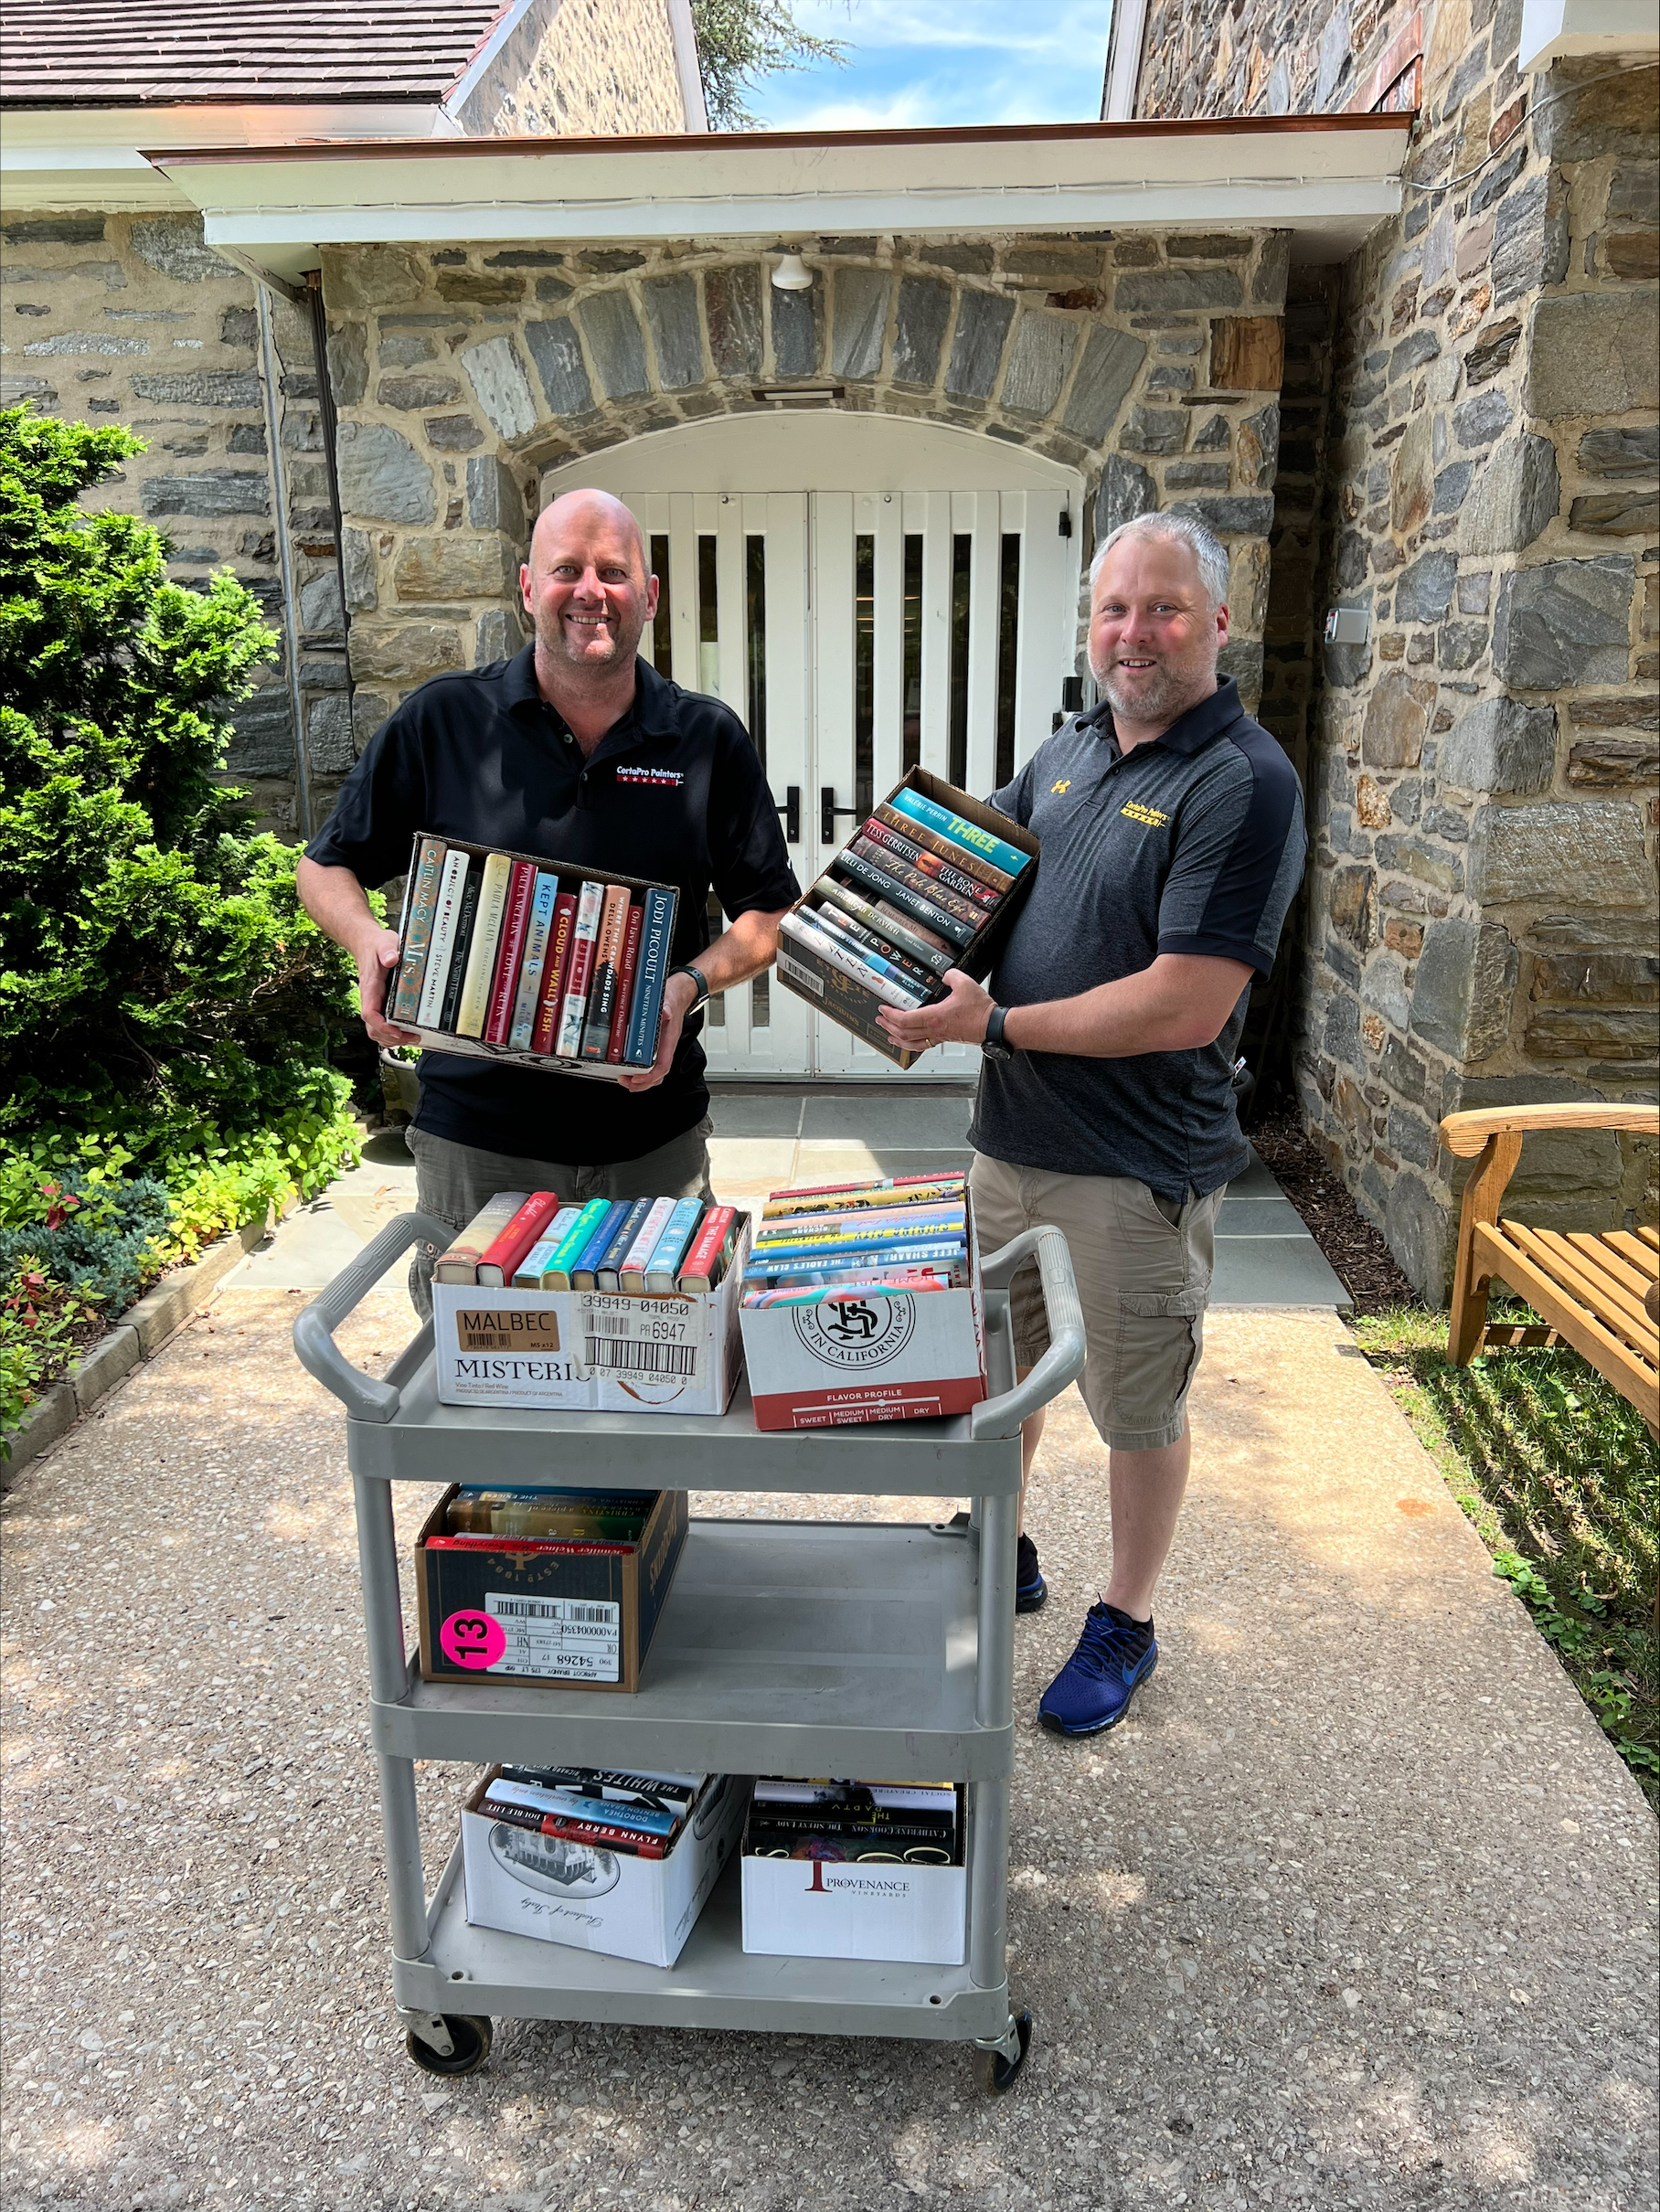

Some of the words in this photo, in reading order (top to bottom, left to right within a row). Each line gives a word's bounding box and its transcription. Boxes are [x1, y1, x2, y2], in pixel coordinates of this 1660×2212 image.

[617, 766, 649, 776] CertaPro
[651, 769, 680, 779] Painters
[905, 795, 926, 810] VALÉRIE
[926, 807, 946, 822] PERRIN
[949, 814, 998, 852] THREE
[867, 824, 884, 839] TESS
[882, 835, 921, 861] GERRITSEN
[883, 813, 925, 843] THREE
[931, 841, 974, 872] JUNES
[422, 850, 436, 888] CAITLIN
[453, 856, 460, 867] AN
[447, 869, 458, 896] OBJECT
[517, 867, 528, 897] PAULA
[885, 857, 903, 875] The
[905, 873, 926, 888] Pale
[924, 885, 947, 901] Blue
[948, 899, 964, 917] Eye
[939, 870, 974, 897] GARDEN
[941, 867, 956, 878] THE
[957, 877, 980, 894] BONE
[466, 884, 475, 899] Alice
[491, 884, 503, 909] PAULA
[841, 855, 857, 867] LILLI
[857, 864, 868, 875] DE
[867, 873, 890, 888] JONG
[896, 890, 920, 907] JANET
[920, 904, 951, 926] BENTON
[417, 892, 429, 922] MACY
[446, 899, 452, 909] OF
[538, 885, 551, 915] KEPT
[607, 903, 616, 926] DELIA
[615, 897, 624, 924] WHERE
[631, 911, 640, 924] On
[653, 894, 667, 924] JODI
[440, 912, 450, 941] BEAUTY
[460, 902, 473, 937] McDermott
[556, 917, 569, 953] CLOUD
[628, 927, 638, 944] Java
[529, 920, 545, 975] ANIMALS
[601, 930, 612, 958] OWENS
[403, 939, 425, 977] Mrs.
[455, 951, 464, 962] The
[480, 947, 490, 980] CIRCLING
[625, 947, 634, 970] Road
[645, 929, 661, 983] PICOULT
[870, 937, 923, 975] POWER
[432, 954, 442, 976] STEVE
[503, 952, 514, 979] LOVE
[604, 946, 616, 991] CRAWDADS
[548, 970, 560, 998] WALL
[427, 979, 436, 1007] MARTIN
[620, 979, 629, 1010] Lawrence
[642, 985, 651, 1016] NINETEEN
[496, 991, 507, 1016] RUIN
[601, 993, 609, 1013] SING
[516, 1003, 527, 1037] MILLIKEN
[522, 1012, 531, 1029] KATE
[542, 1007, 553, 1032] FISH
[616, 1011, 624, 1037] Osborne
[638, 1018, 646, 1046] MINUTES
[718, 1207, 731, 1223] CAITLIN
[706, 1226, 719, 1236] THE
[791, 1226, 828, 1234] RICHARD
[696, 1237, 714, 1259] DAMAGE
[883, 1251, 928, 1262] SHAARA
[930, 1249, 959, 1258] JEFF
[767, 1262, 790, 1271] CLAW
[847, 1278, 886, 1287] FIRE
[583, 1295, 689, 1315] 39949-04050
[463, 1313, 550, 1331] MALBEC
[641, 1324, 650, 1335] PA
[653, 1322, 686, 1341] 6947
[810, 1332, 826, 1349] IN
[827, 1324, 904, 1362] CALIFORNIA
[600, 1368, 611, 1377] 07
[616, 1370, 644, 1380] 39949
[649, 1373, 676, 1384] 04050
[682, 1377, 687, 1385] 0
[827, 1392, 862, 1402] FLAVOR
[864, 1389, 902, 1398] PROFILE
[833, 1409, 864, 1418] MEDIUM
[913, 1407, 930, 1415] DRY
[800, 1416, 826, 1424] SWEET
[836, 1416, 863, 1424] SWEET
[485, 1492, 517, 1500] EXILES
[452, 1539, 505, 1549] Everything
[560, 1623, 617, 1636] PA000004350
[453, 1618, 488, 1660] 13
[516, 1635, 529, 1647] NH
[607, 1643, 617, 1654] OR
[557, 1655, 592, 1666] 54268
[551, 1766, 580, 1776] RICHARD
[592, 1770, 658, 1791] WHITES
[660, 1785, 678, 1793] THE
[512, 1786, 528, 1794] only
[530, 1792, 567, 1802] invitation
[488, 1804, 505, 1813] LIFE
[569, 1797, 579, 1806] by
[598, 1800, 625, 1811] FRANK
[509, 1809, 540, 1820] DOUBLE
[604, 1809, 648, 1823] DOROTHEA
[627, 1807, 660, 1817] BENTON
[872, 1812, 889, 1820] THE
[578, 1823, 615, 1835] BERRY
[853, 1825, 893, 1834] COOKSON
[895, 1828, 946, 1838] CATHERINE
[621, 1832, 658, 1845] FLYNN
[826, 1877, 910, 1892] PROVENANCE
[851, 1890, 907, 1898] VINEYARDS
[521, 1898, 549, 1914] Italy
[548, 1905, 563, 1915] of
[563, 1910, 603, 1927] Product
